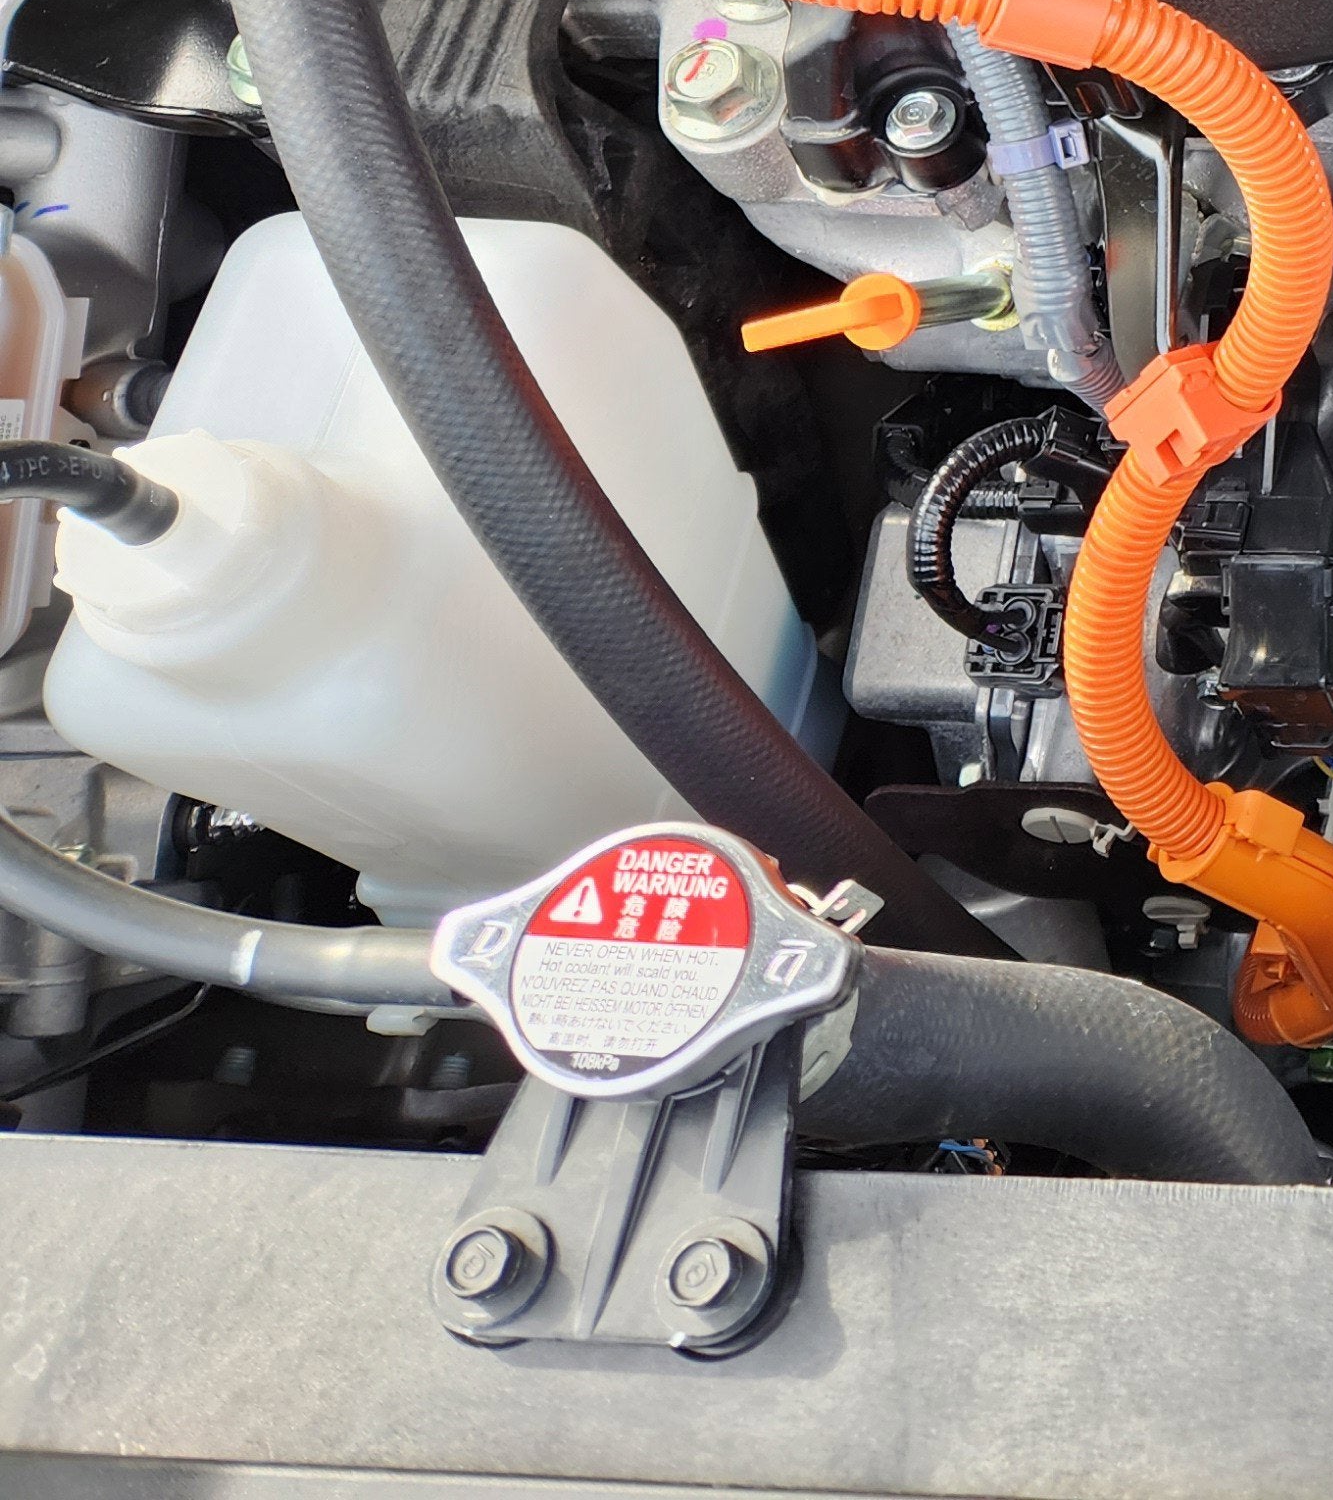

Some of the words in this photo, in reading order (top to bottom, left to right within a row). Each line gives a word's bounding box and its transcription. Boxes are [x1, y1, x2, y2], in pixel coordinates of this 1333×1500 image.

[617, 848, 714, 876] DANGER
[612, 871, 729, 899] WARNUNG
[545, 940, 595, 959] NEVER
[596, 944, 636, 961] OPEN
[640, 947, 683, 964] WHEN
[688, 949, 719, 967] HOT.
[538, 959, 564, 973] Hot
[564, 961, 610, 977] coolant
[614, 964, 633, 977] will
[636, 965, 671, 980] scald
[673, 969, 699, 983] you.
[520, 975, 589, 993] N'OUVREZ
[591, 979, 617, 995] PAS
[620, 982, 669, 998] QUAND
[553, 996, 572, 1010] BEI
[573, 997, 622, 1013] HEISSEM
[623, 1000, 662, 1017] MOTOR
[570, 1052, 620, 1072] 108kPa
